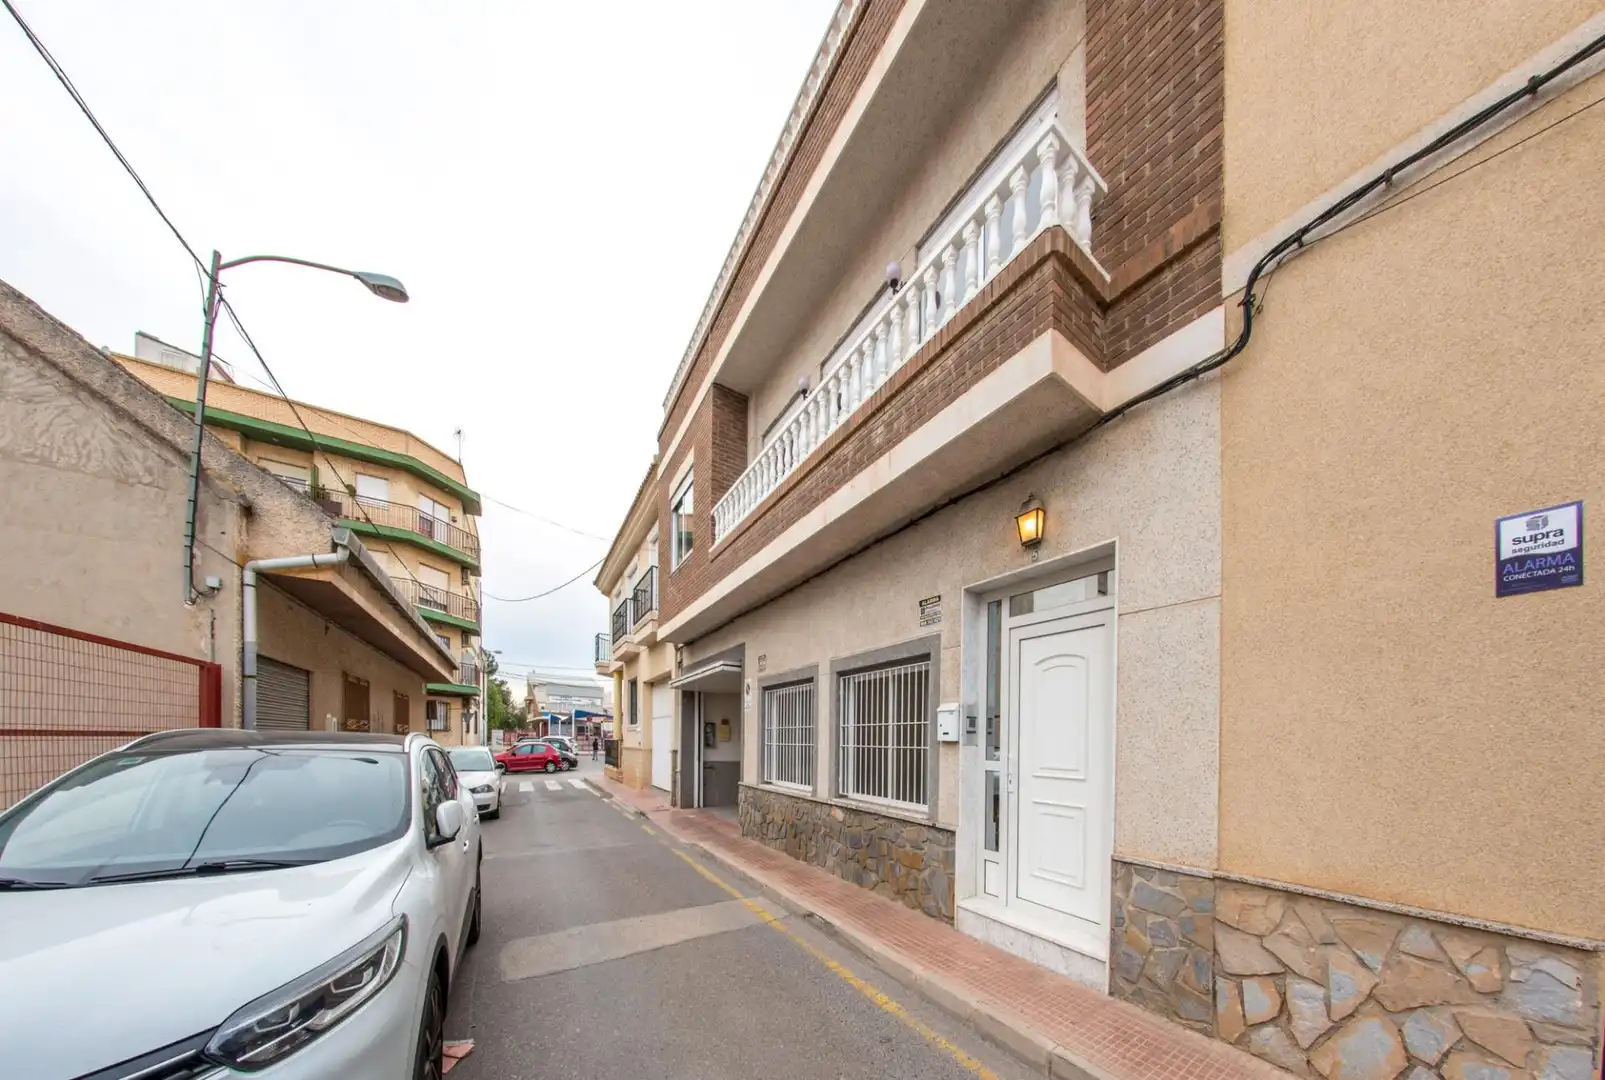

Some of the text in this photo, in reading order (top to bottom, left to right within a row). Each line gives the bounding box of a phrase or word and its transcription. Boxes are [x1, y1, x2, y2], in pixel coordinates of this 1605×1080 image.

[1512, 528, 1564, 546] supra
[1511, 538, 1565, 554] seguridad
[1503, 553, 1576, 574] ALARMA
[1503, 567, 1556, 582] CONECTADA
[1558, 565, 1576, 573] 24h
